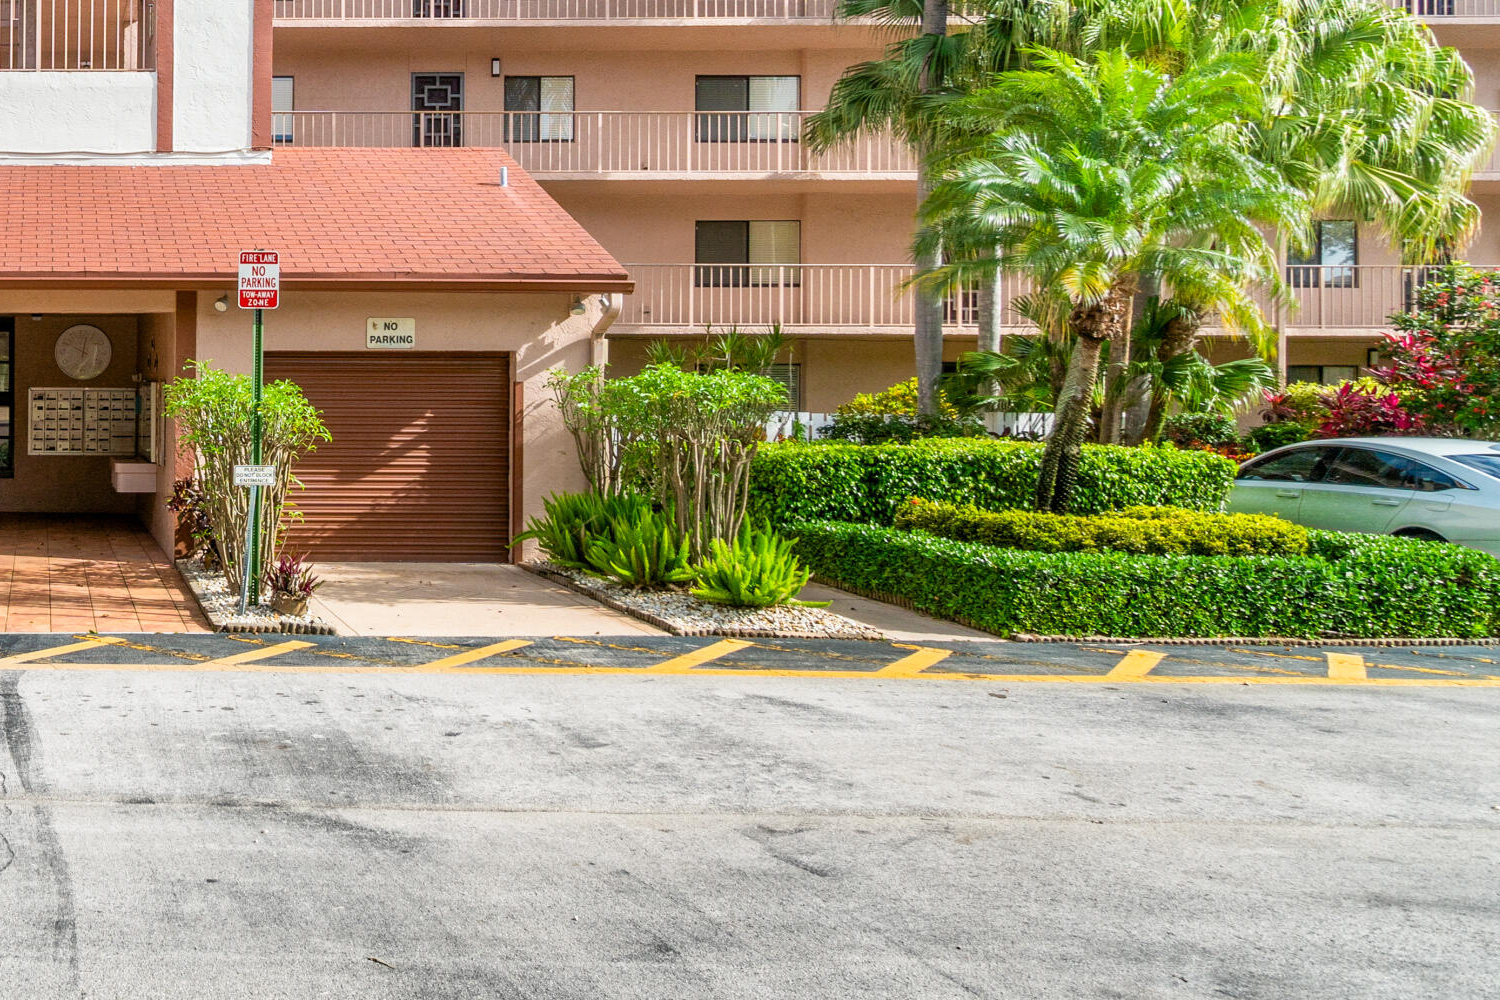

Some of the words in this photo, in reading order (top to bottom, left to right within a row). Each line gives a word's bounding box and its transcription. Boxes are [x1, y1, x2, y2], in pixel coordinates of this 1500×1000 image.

[241, 253, 258, 263] FIRE
[259, 253, 277, 263] LANE
[252, 265, 266, 276] NO
[241, 277, 276, 288] PARKING
[242, 290, 275, 298] TOW-AWAY
[247, 298, 269, 306] ZONE
[383, 322, 398, 331] NO
[369, 335, 413, 344] PARKING
